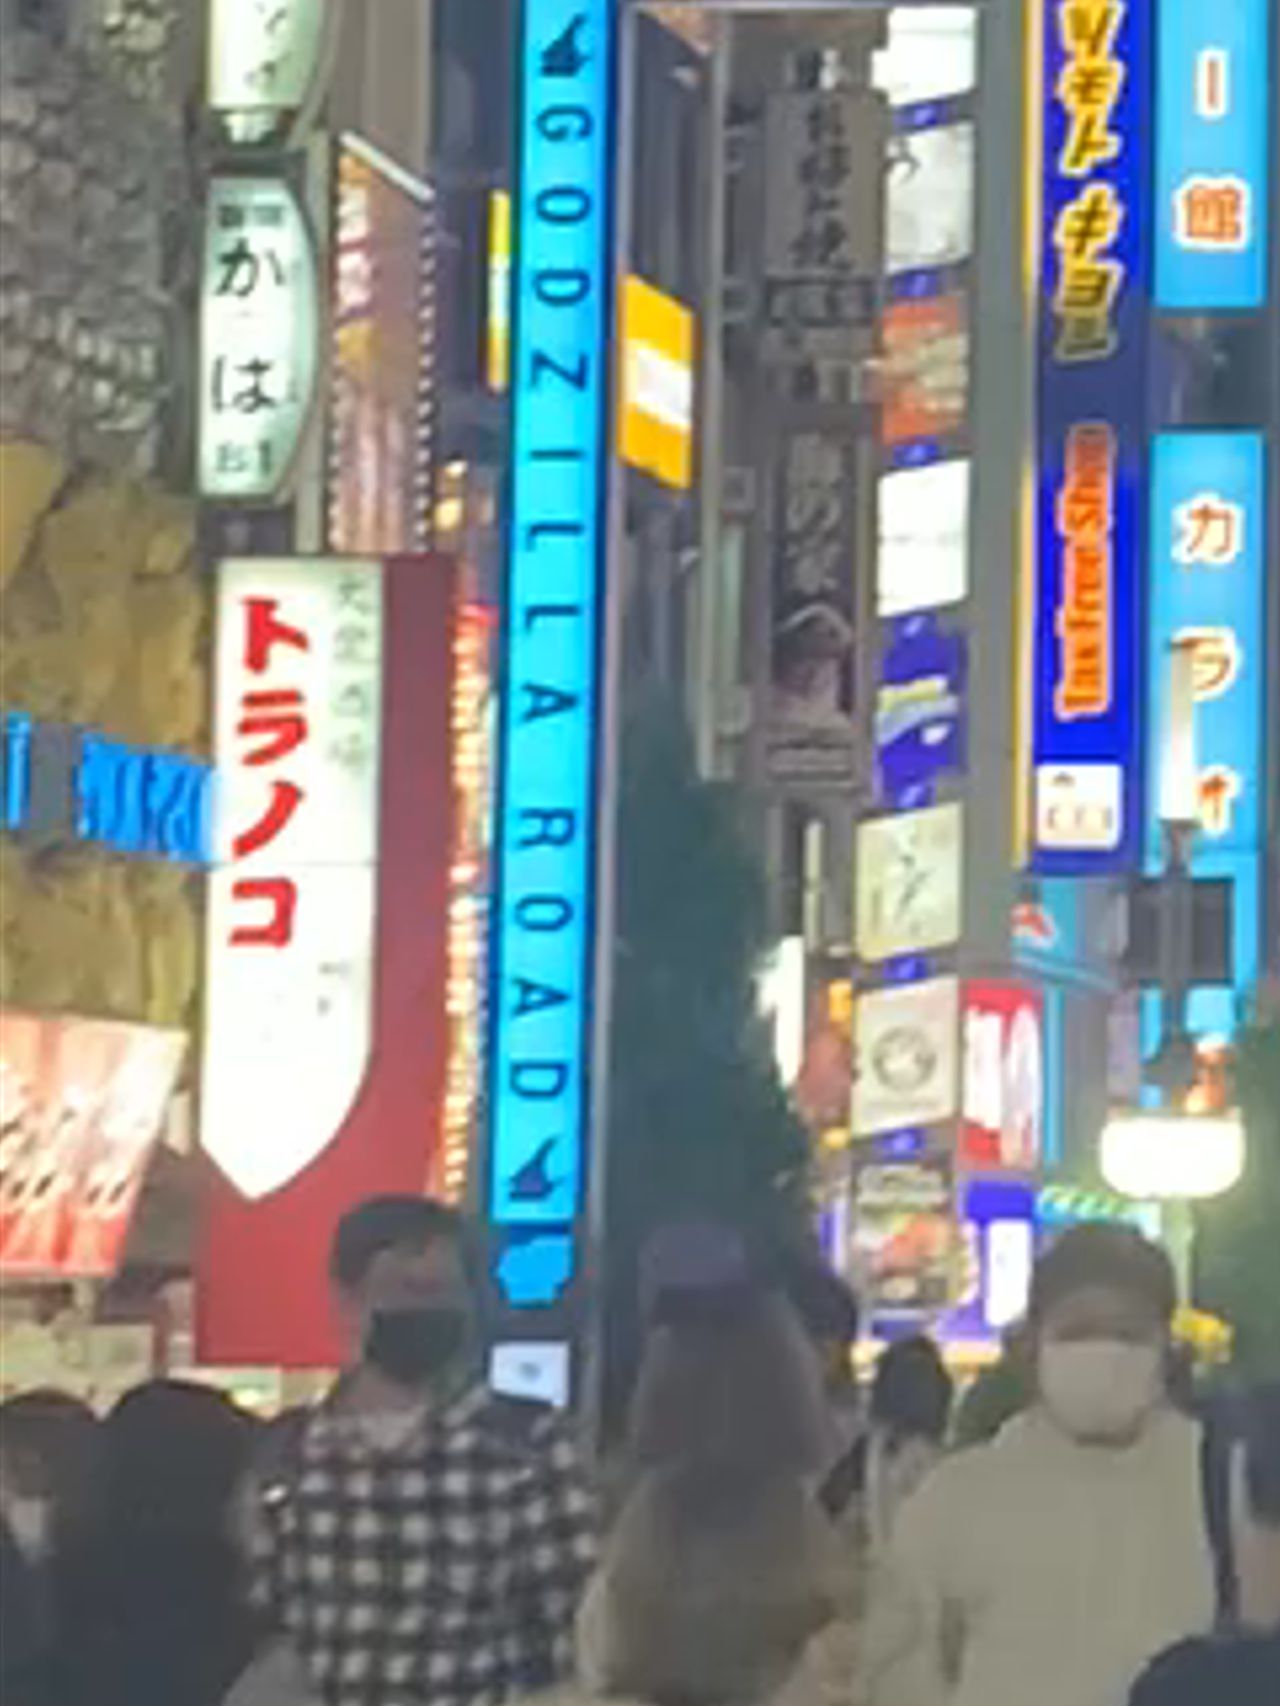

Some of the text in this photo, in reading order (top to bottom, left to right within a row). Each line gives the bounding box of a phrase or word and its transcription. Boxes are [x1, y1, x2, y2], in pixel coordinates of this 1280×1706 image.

[227, 595, 310, 950] トラノコ
[508, 105, 594, 1103] GODZILLA ROAD
